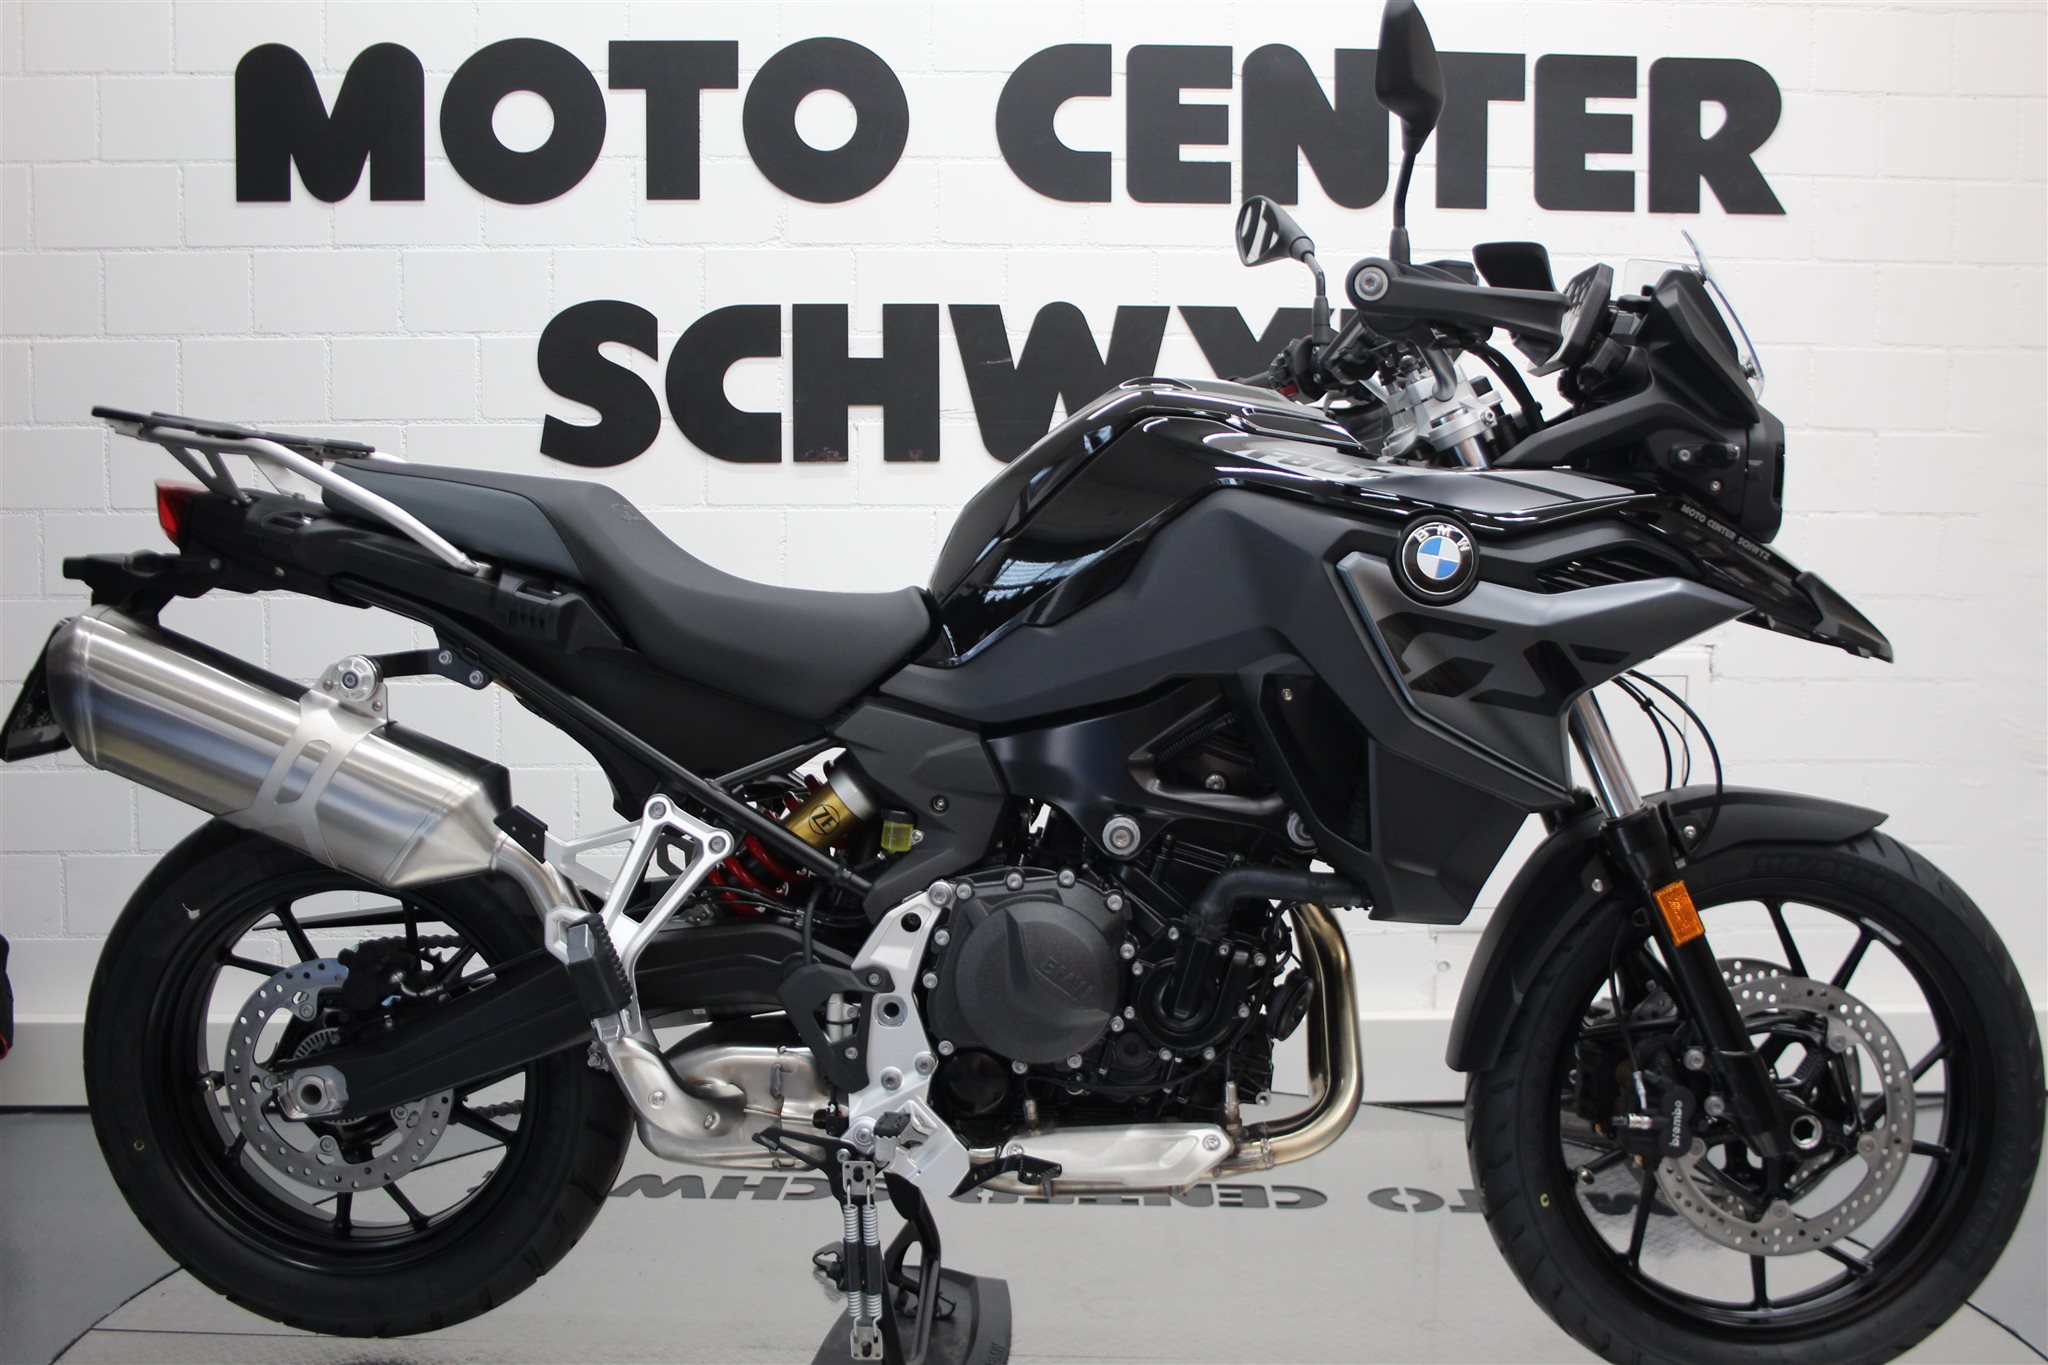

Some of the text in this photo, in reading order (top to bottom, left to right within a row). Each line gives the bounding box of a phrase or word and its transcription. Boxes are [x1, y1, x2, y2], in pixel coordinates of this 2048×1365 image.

[235, 37, 1787, 215] MOTO CENTER
[537, 300, 1358, 468] SCHWY
[1413, 523, 1471, 552] BMW
[1681, 504, 1706, 523] MOTO
[1707, 519, 1737, 541] CENTER
[1668, 1100, 1683, 1148] brembo
